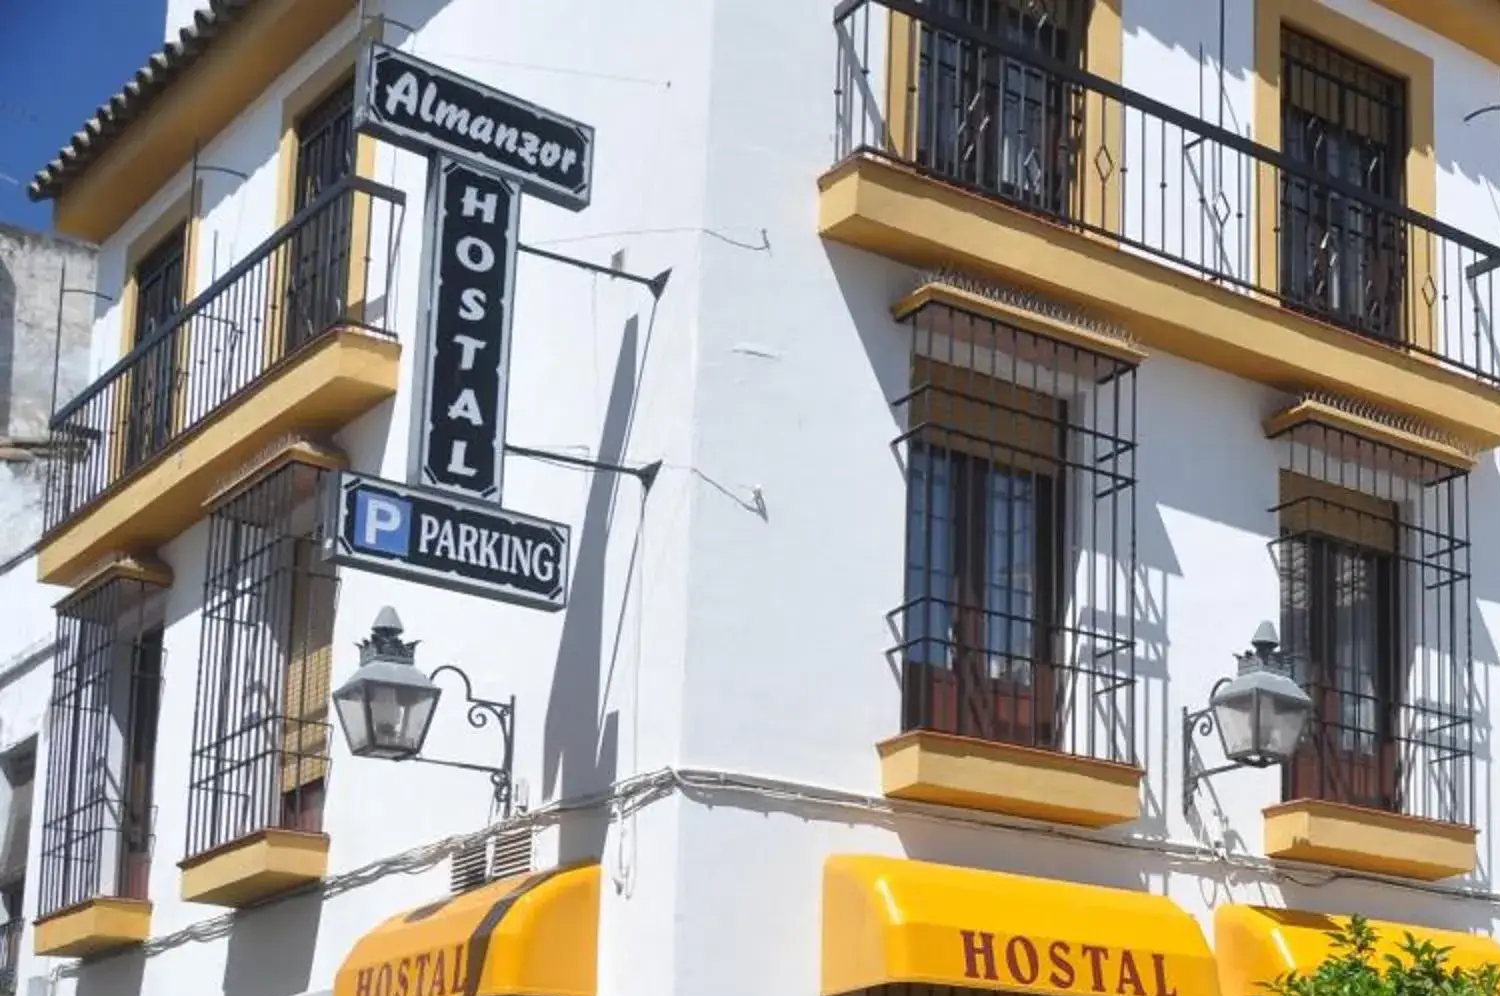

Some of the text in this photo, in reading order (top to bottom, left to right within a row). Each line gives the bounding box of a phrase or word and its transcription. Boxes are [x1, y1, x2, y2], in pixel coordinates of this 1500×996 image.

[386, 70, 577, 174] Almanzor
[447, 186, 497, 477] HOSTAL
[364, 495, 555, 583] P PARKING
